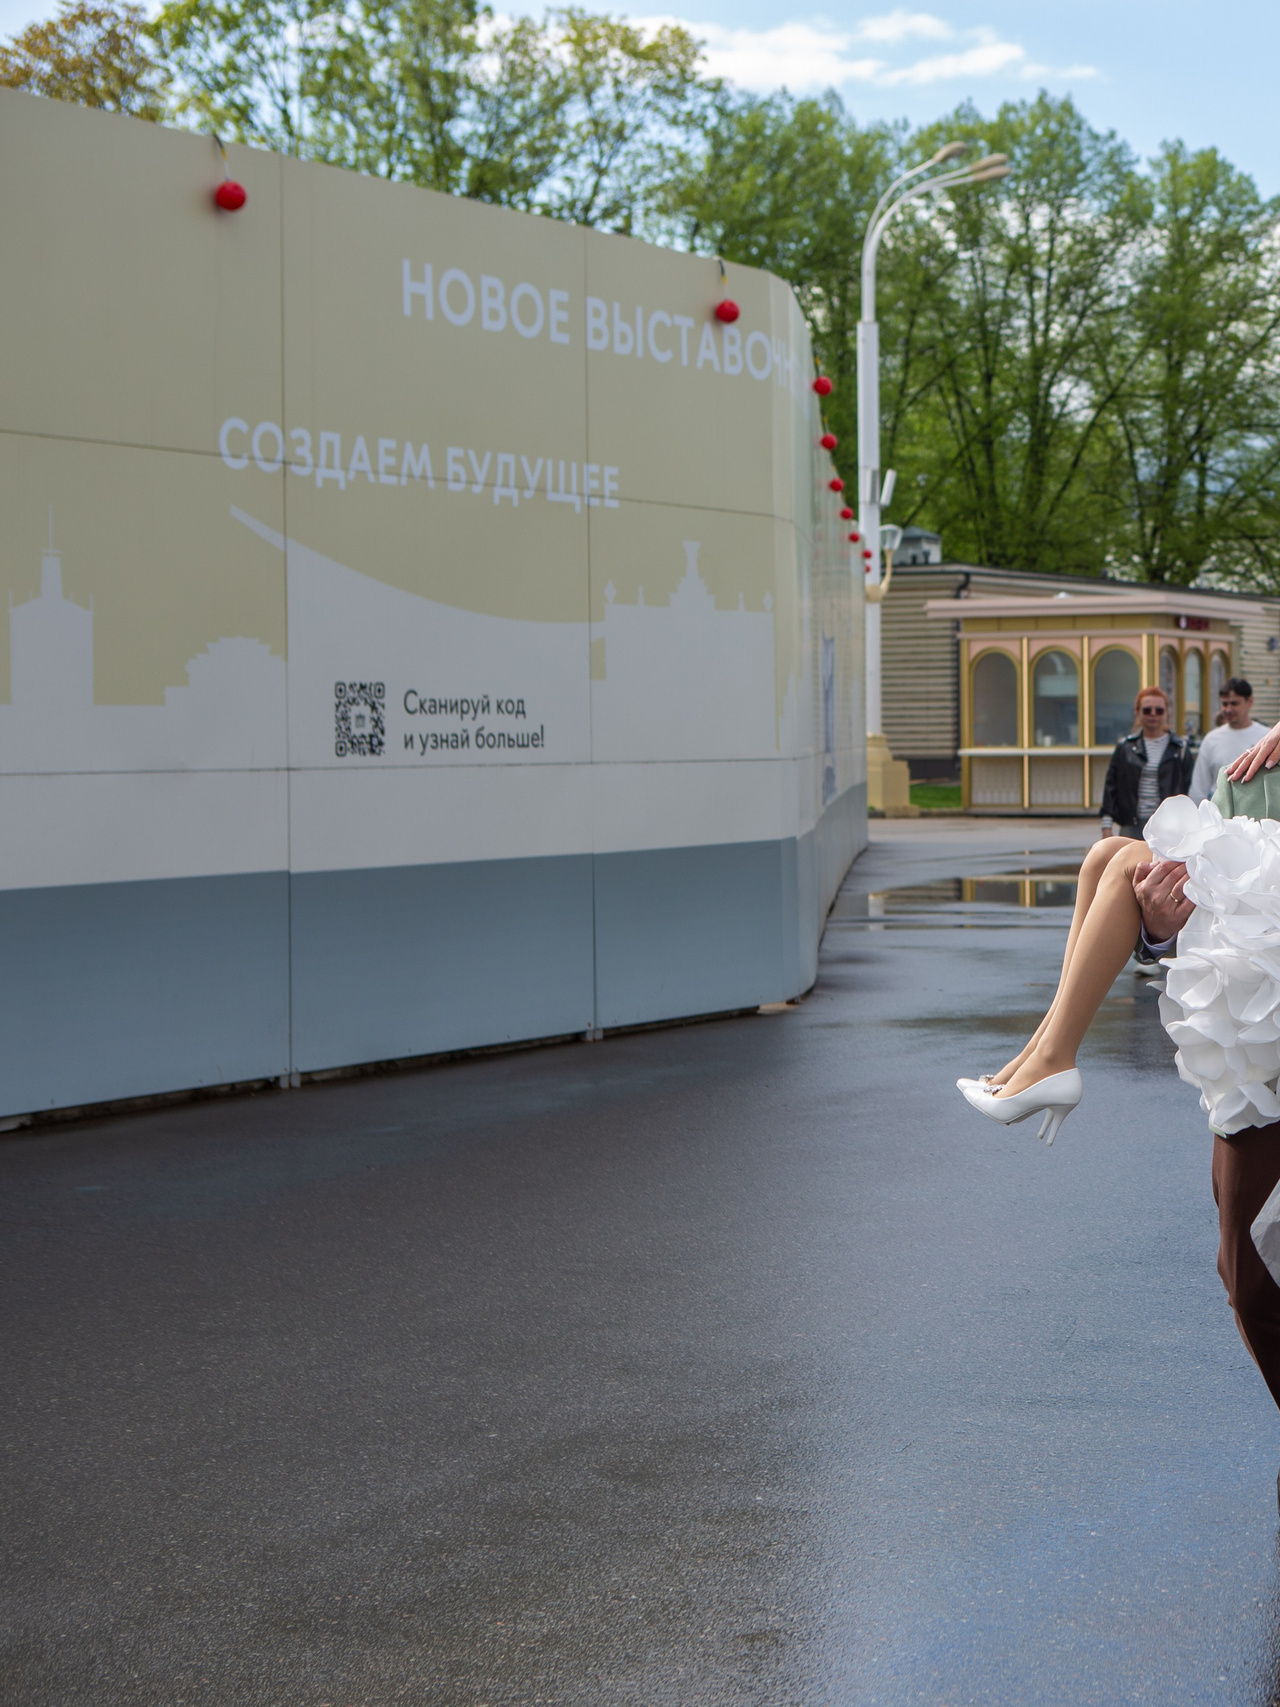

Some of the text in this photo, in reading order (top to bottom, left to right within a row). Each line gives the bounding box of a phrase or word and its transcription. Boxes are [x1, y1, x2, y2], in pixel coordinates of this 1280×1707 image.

[402, 257, 570, 346] НОВОЕ
[219, 417, 619, 513] СОЗДАЕМ БУДУЩЕЕ
[403, 689, 527, 721] Сканируй код
[404, 724, 544, 756] и узнай больше!
